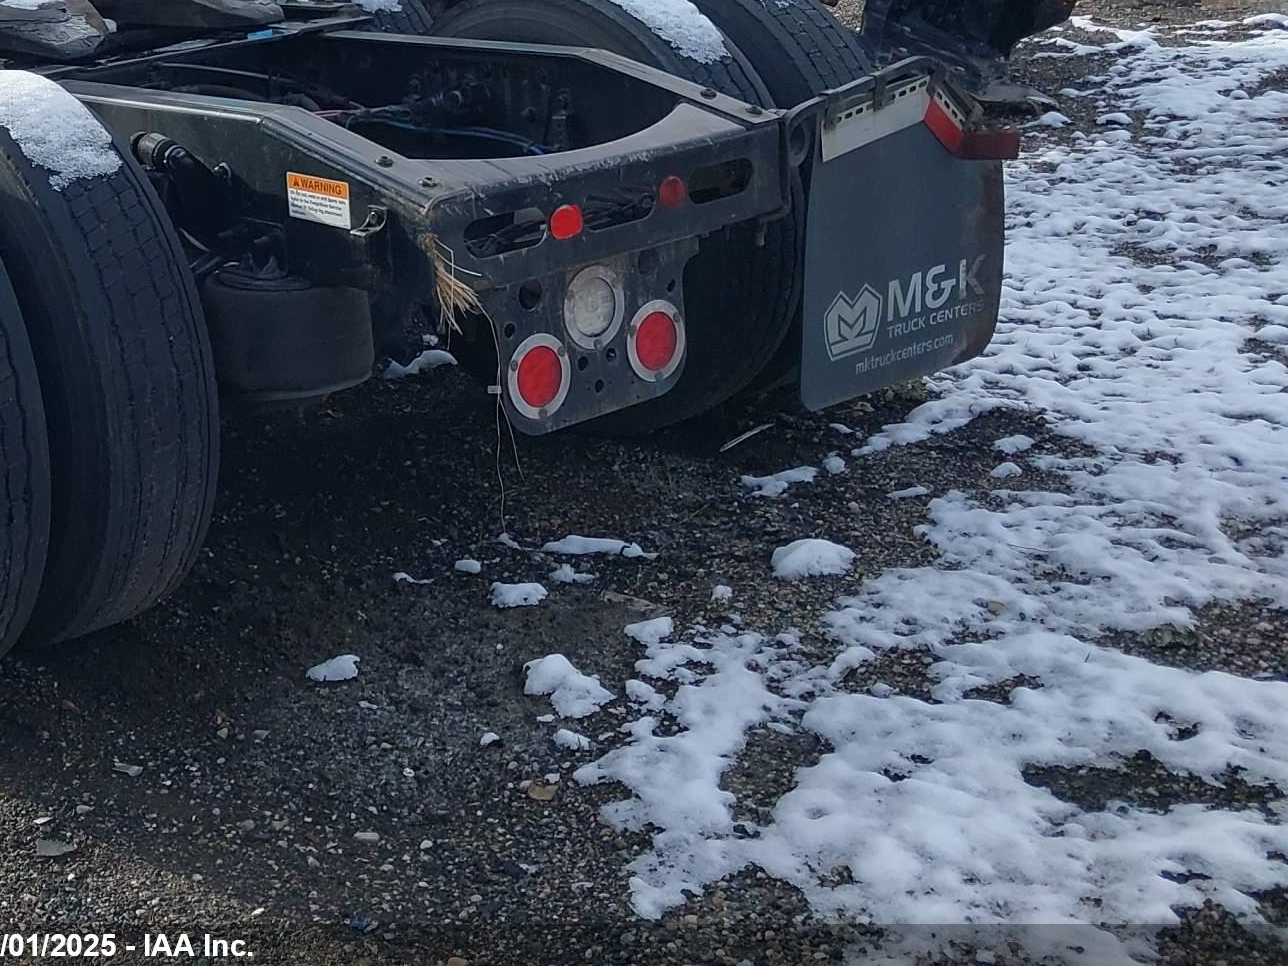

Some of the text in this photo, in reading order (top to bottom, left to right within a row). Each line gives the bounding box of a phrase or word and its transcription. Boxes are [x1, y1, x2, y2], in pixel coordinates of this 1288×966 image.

[300, 177, 342, 195] WARNING
[887, 253, 986, 322] M&K
[887, 316, 926, 339] TRUCK
[855, 333, 954, 375] mktruckcenters.com
